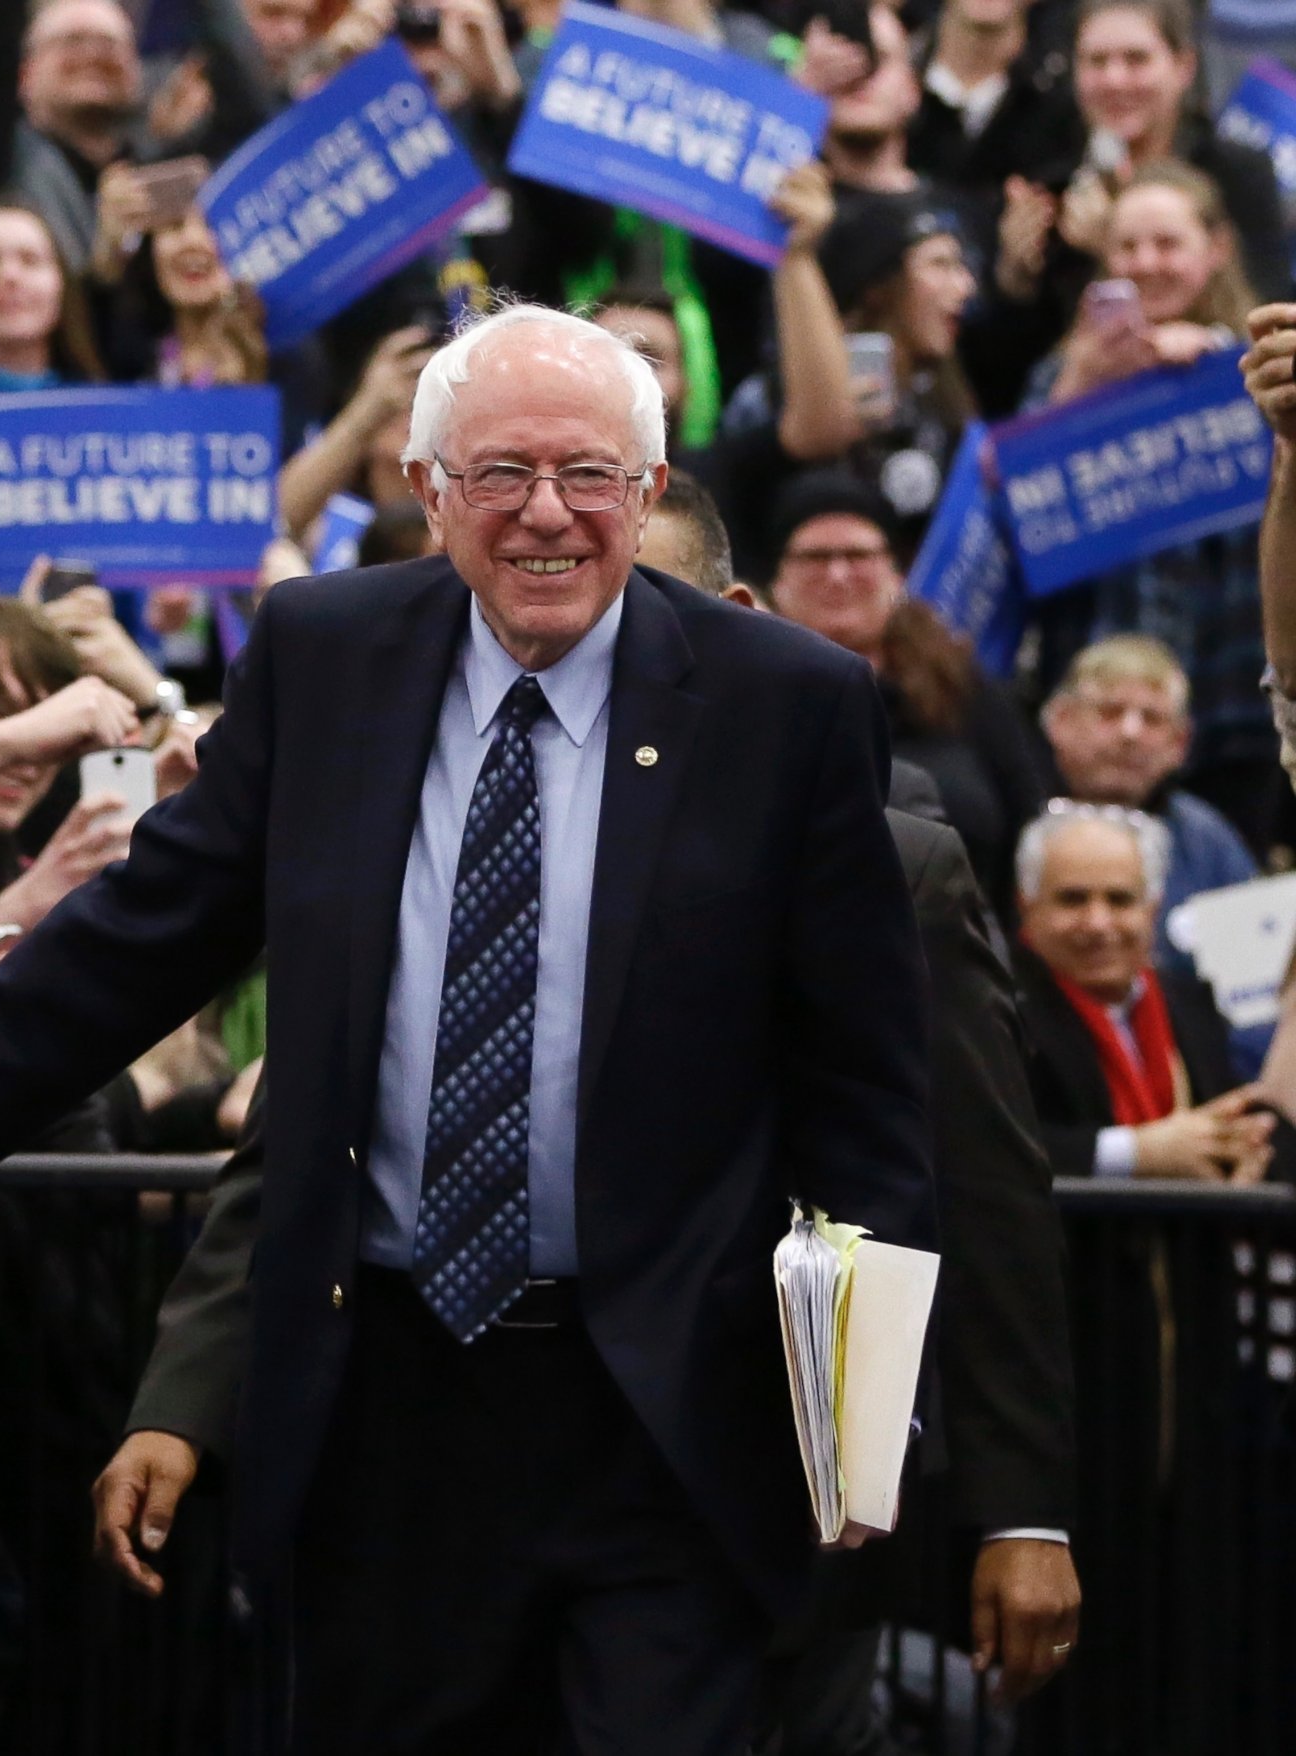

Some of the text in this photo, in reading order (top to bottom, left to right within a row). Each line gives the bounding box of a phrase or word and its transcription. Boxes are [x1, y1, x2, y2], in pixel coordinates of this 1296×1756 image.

[236, 118, 363, 227] FUTURE
[362, 82, 426, 136] TO
[542, 78, 738, 182] BELIEVE
[560, 43, 813, 167] A FUTURE TO
[232, 156, 398, 282] BELIEVE
[389, 118, 452, 178] IN
[20, 433, 195, 478] FUTURE
[206, 432, 272, 476] TO
[208, 478, 271, 523] IN
